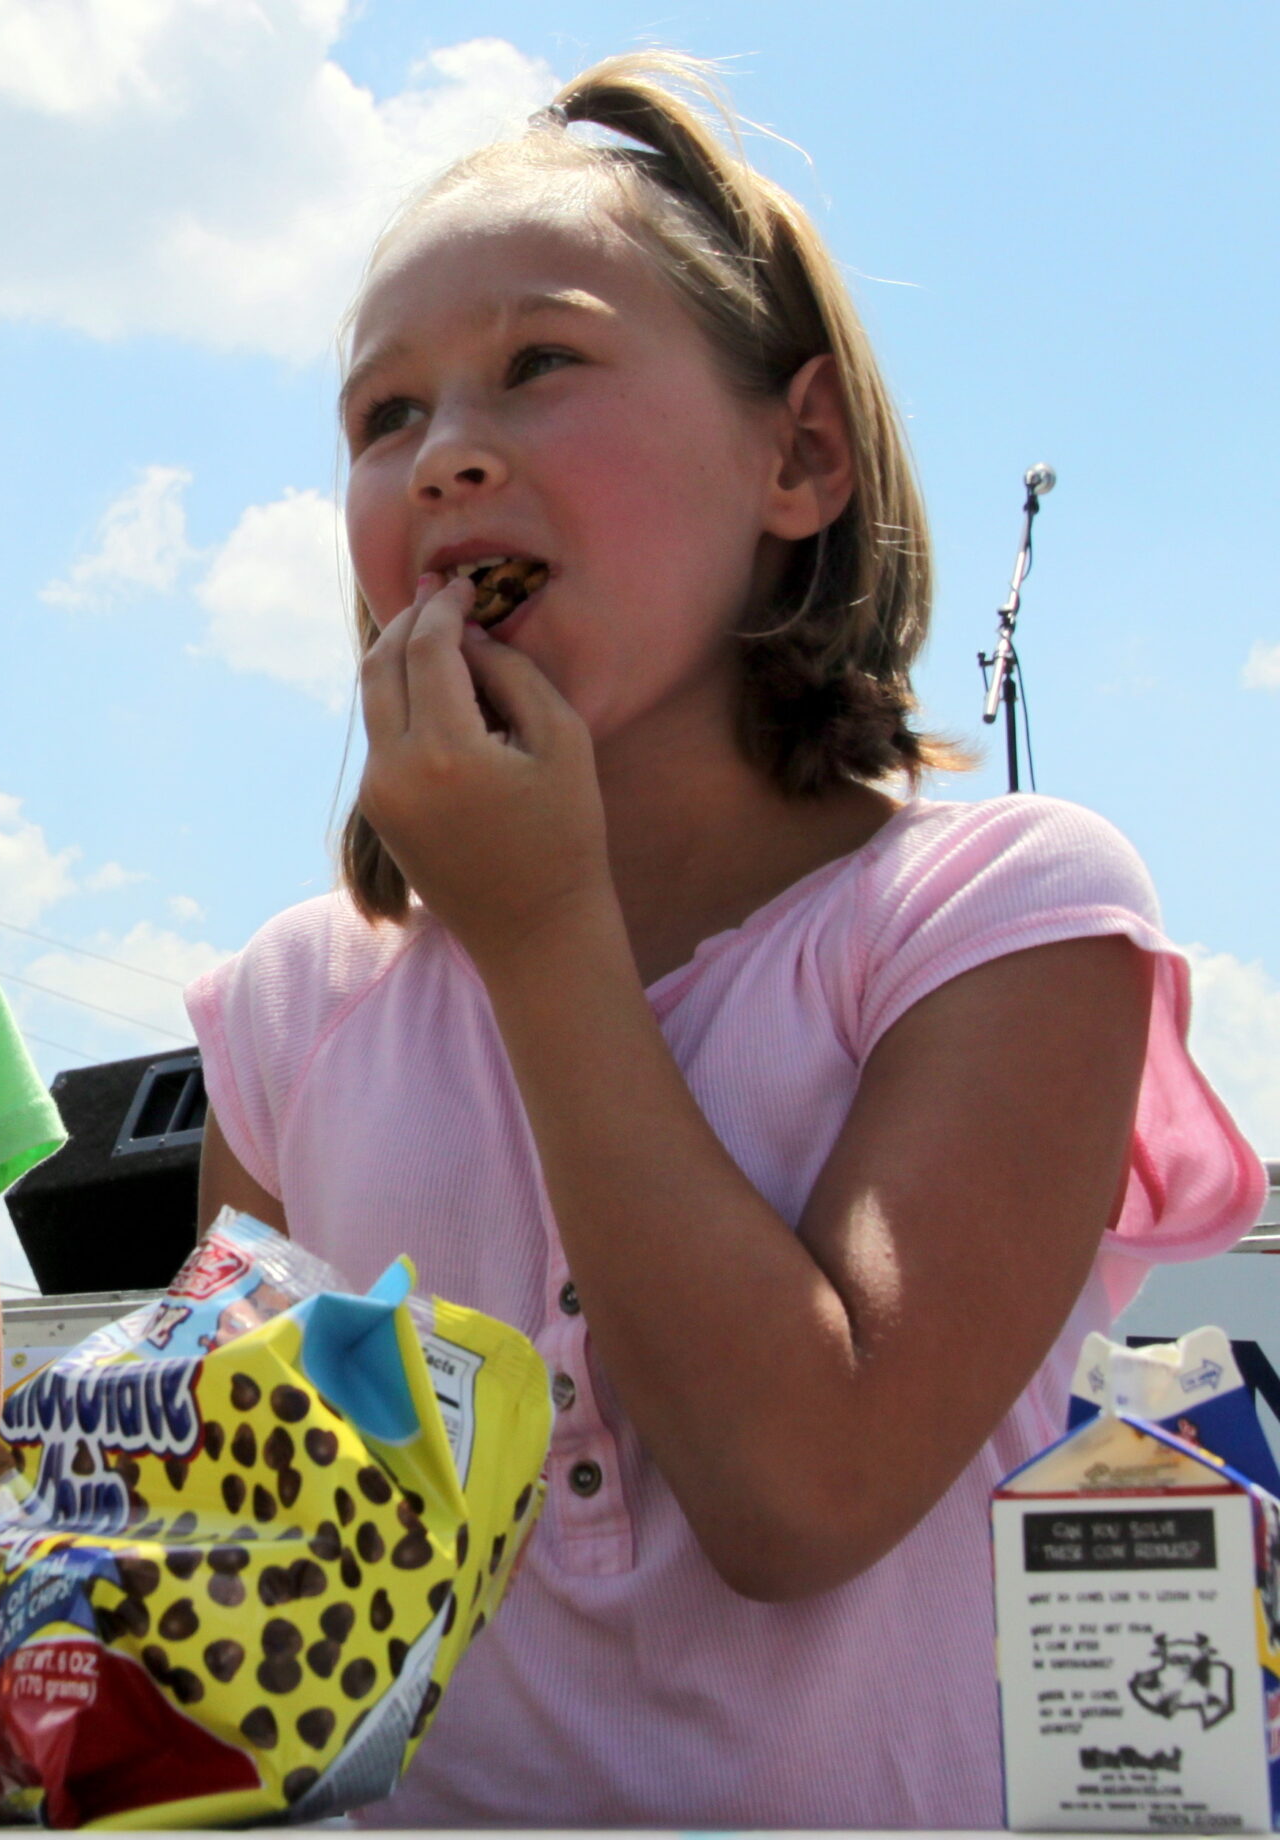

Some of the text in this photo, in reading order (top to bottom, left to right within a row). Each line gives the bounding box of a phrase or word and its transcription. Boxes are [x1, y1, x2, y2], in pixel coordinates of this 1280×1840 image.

[422, 1347, 455, 1376] acts
[12, 1675, 98, 1707] (170 grams)
